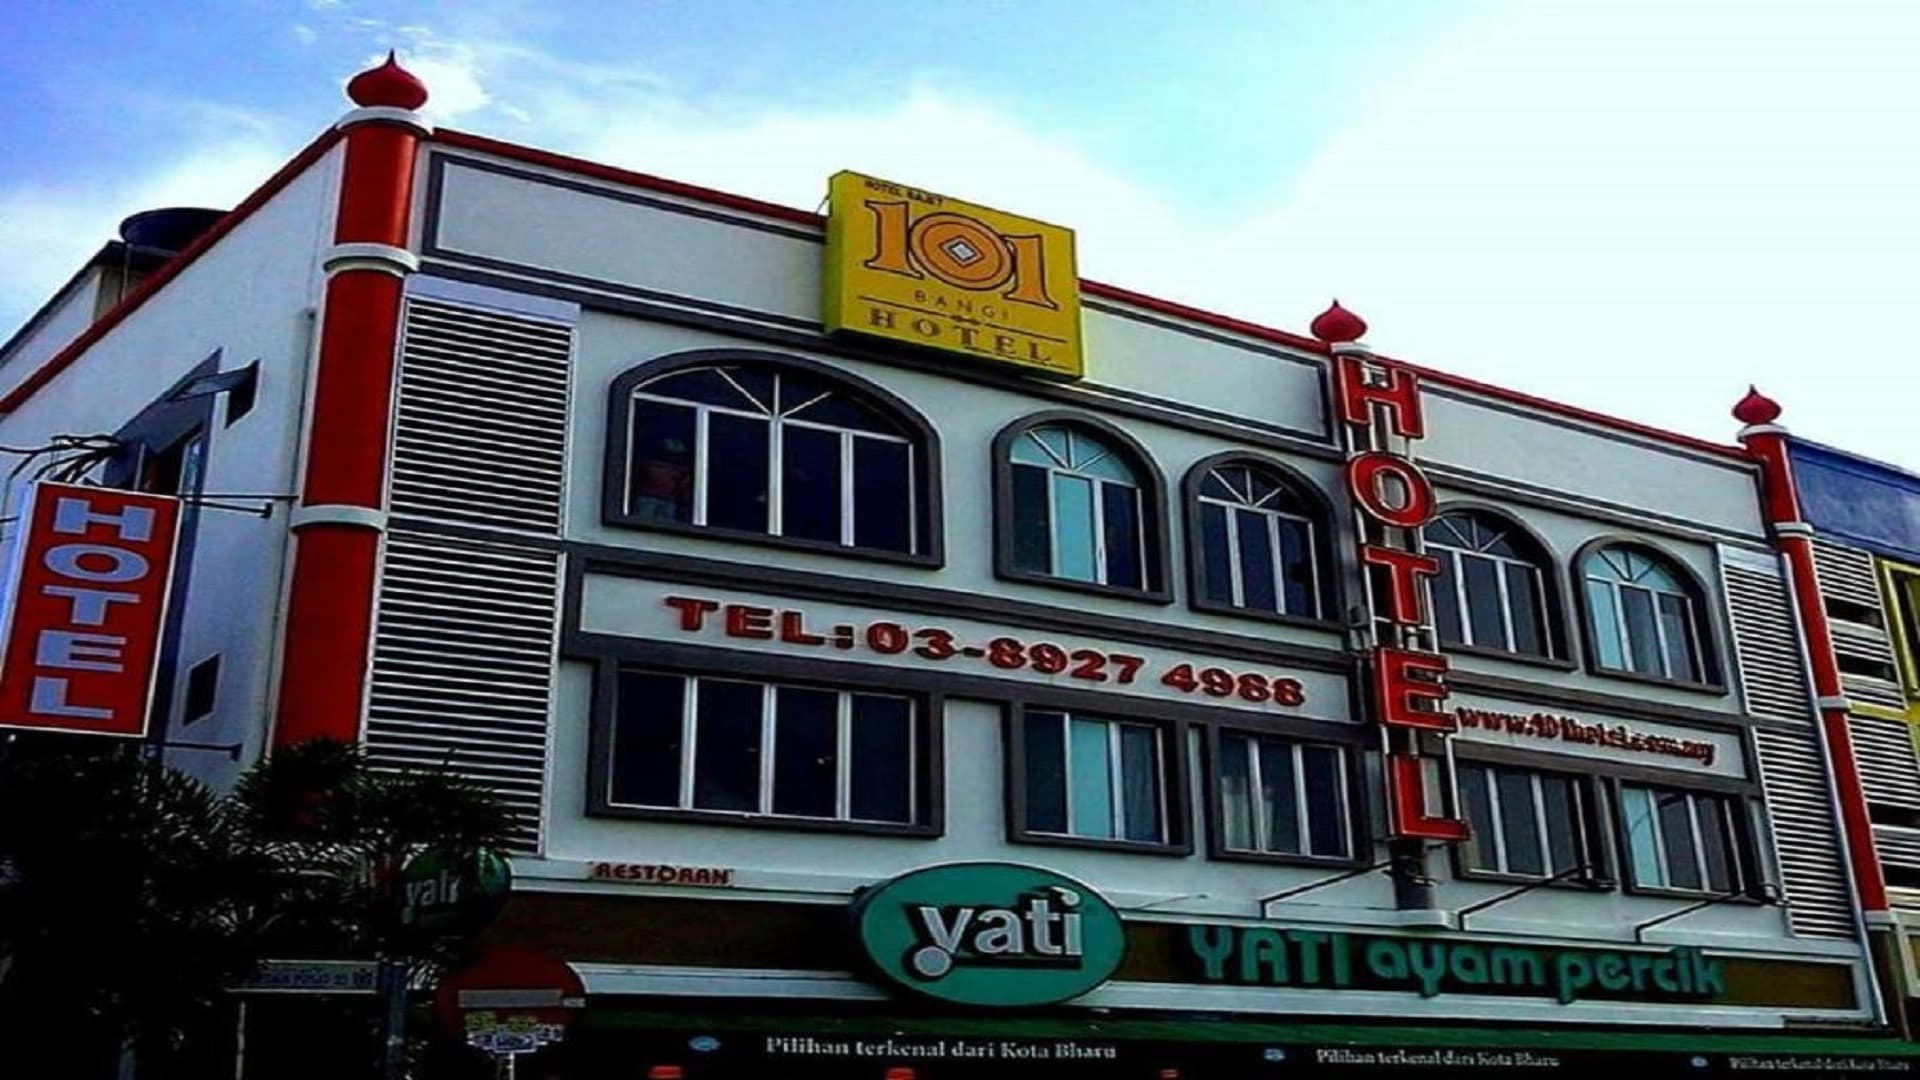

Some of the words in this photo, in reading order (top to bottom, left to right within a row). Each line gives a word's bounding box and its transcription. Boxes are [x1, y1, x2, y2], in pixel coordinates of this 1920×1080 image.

[864, 199, 1059, 310] 101
[869, 308, 1052, 365] HOTEL
[914, 290, 1009, 320] BANGI
[30, 497, 156, 720] HOTEL
[1337, 355, 1471, 842] HOTEL
[595, 862, 730, 884] RESTORAN
[1190, 925, 1351, 986] YATI
[1367, 941, 1546, 997] ayam
[1556, 945, 1728, 1005] percik
[766, 1036, 849, 1054] Pilihan
[855, 1041, 946, 1057] terkenal
[951, 1042, 995, 1058] dari
[1001, 1042, 1050, 1059] Kota
[1055, 1042, 1117, 1059] Bharu
